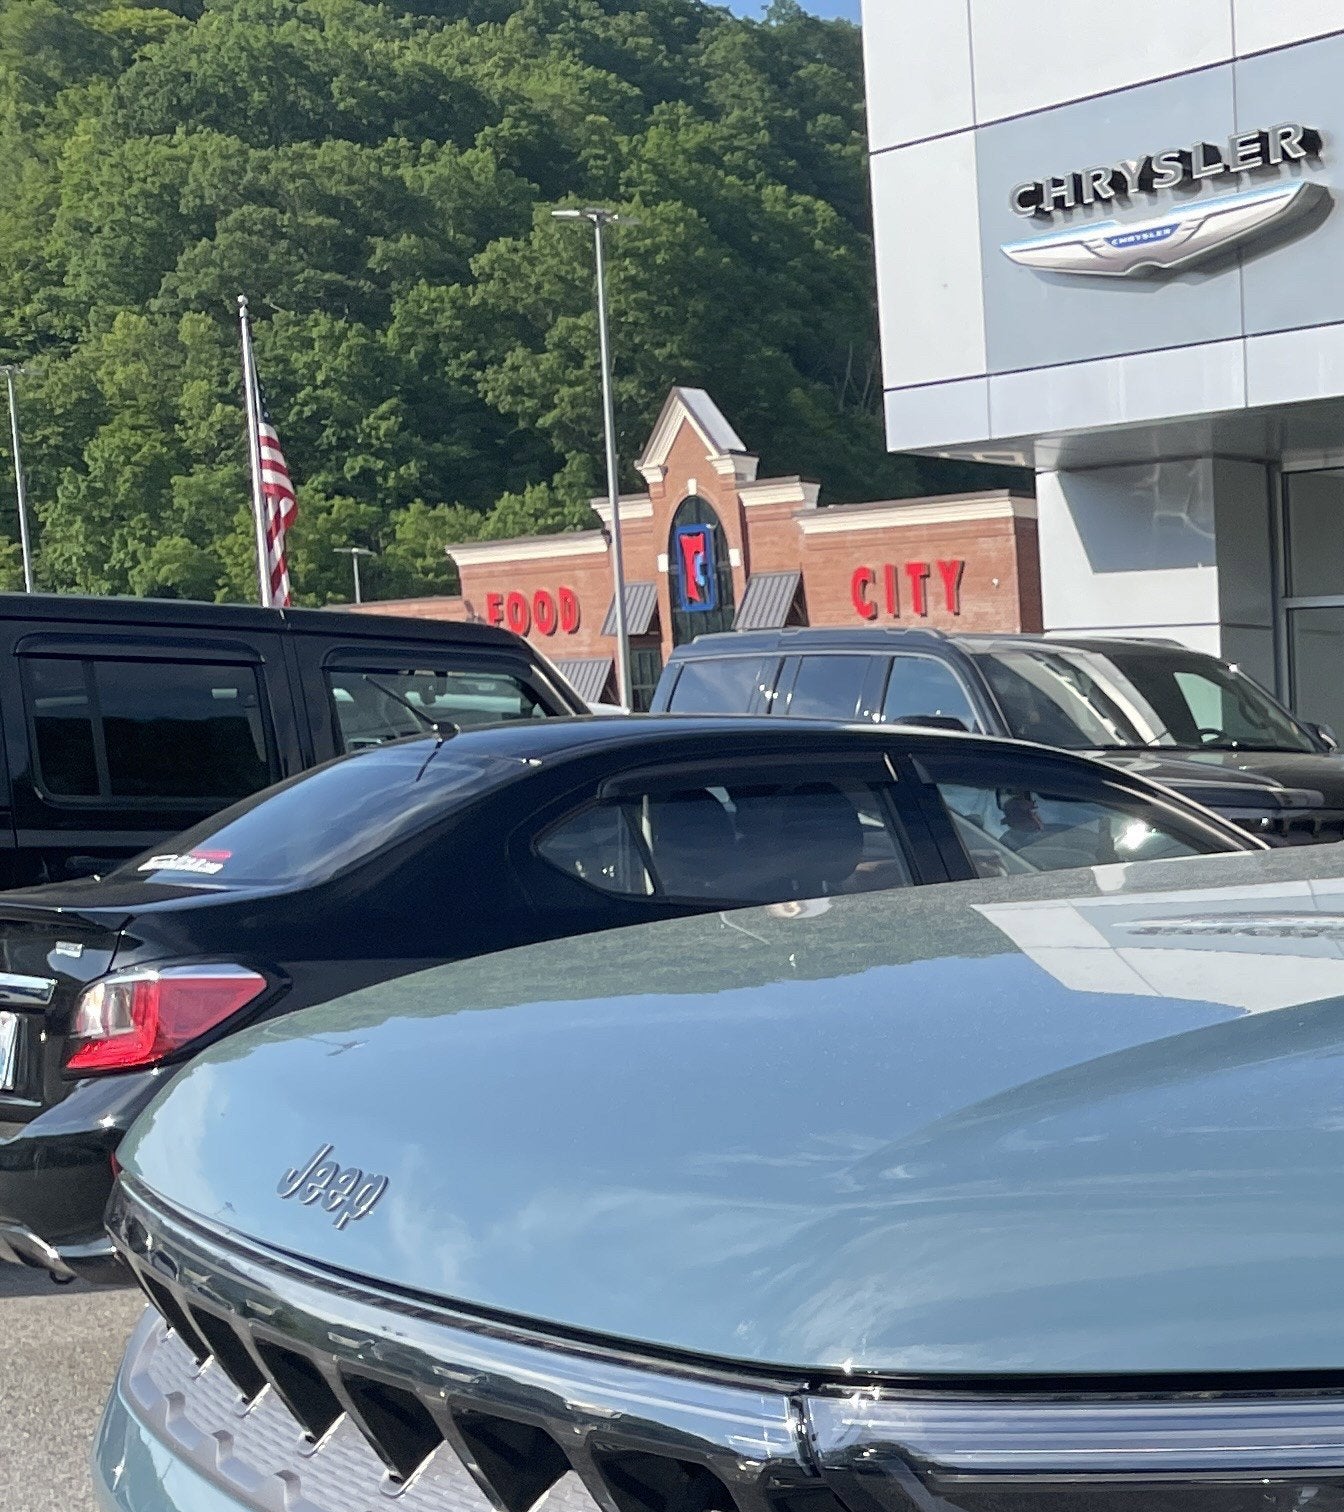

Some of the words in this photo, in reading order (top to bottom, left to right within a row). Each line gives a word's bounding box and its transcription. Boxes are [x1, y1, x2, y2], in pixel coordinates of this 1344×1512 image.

[1009, 122, 1312, 217] CHRYSLER
[486, 586, 580, 636] FOOD
[851, 559, 963, 619] CITY
[276, 1142, 389, 1231] Jeep
